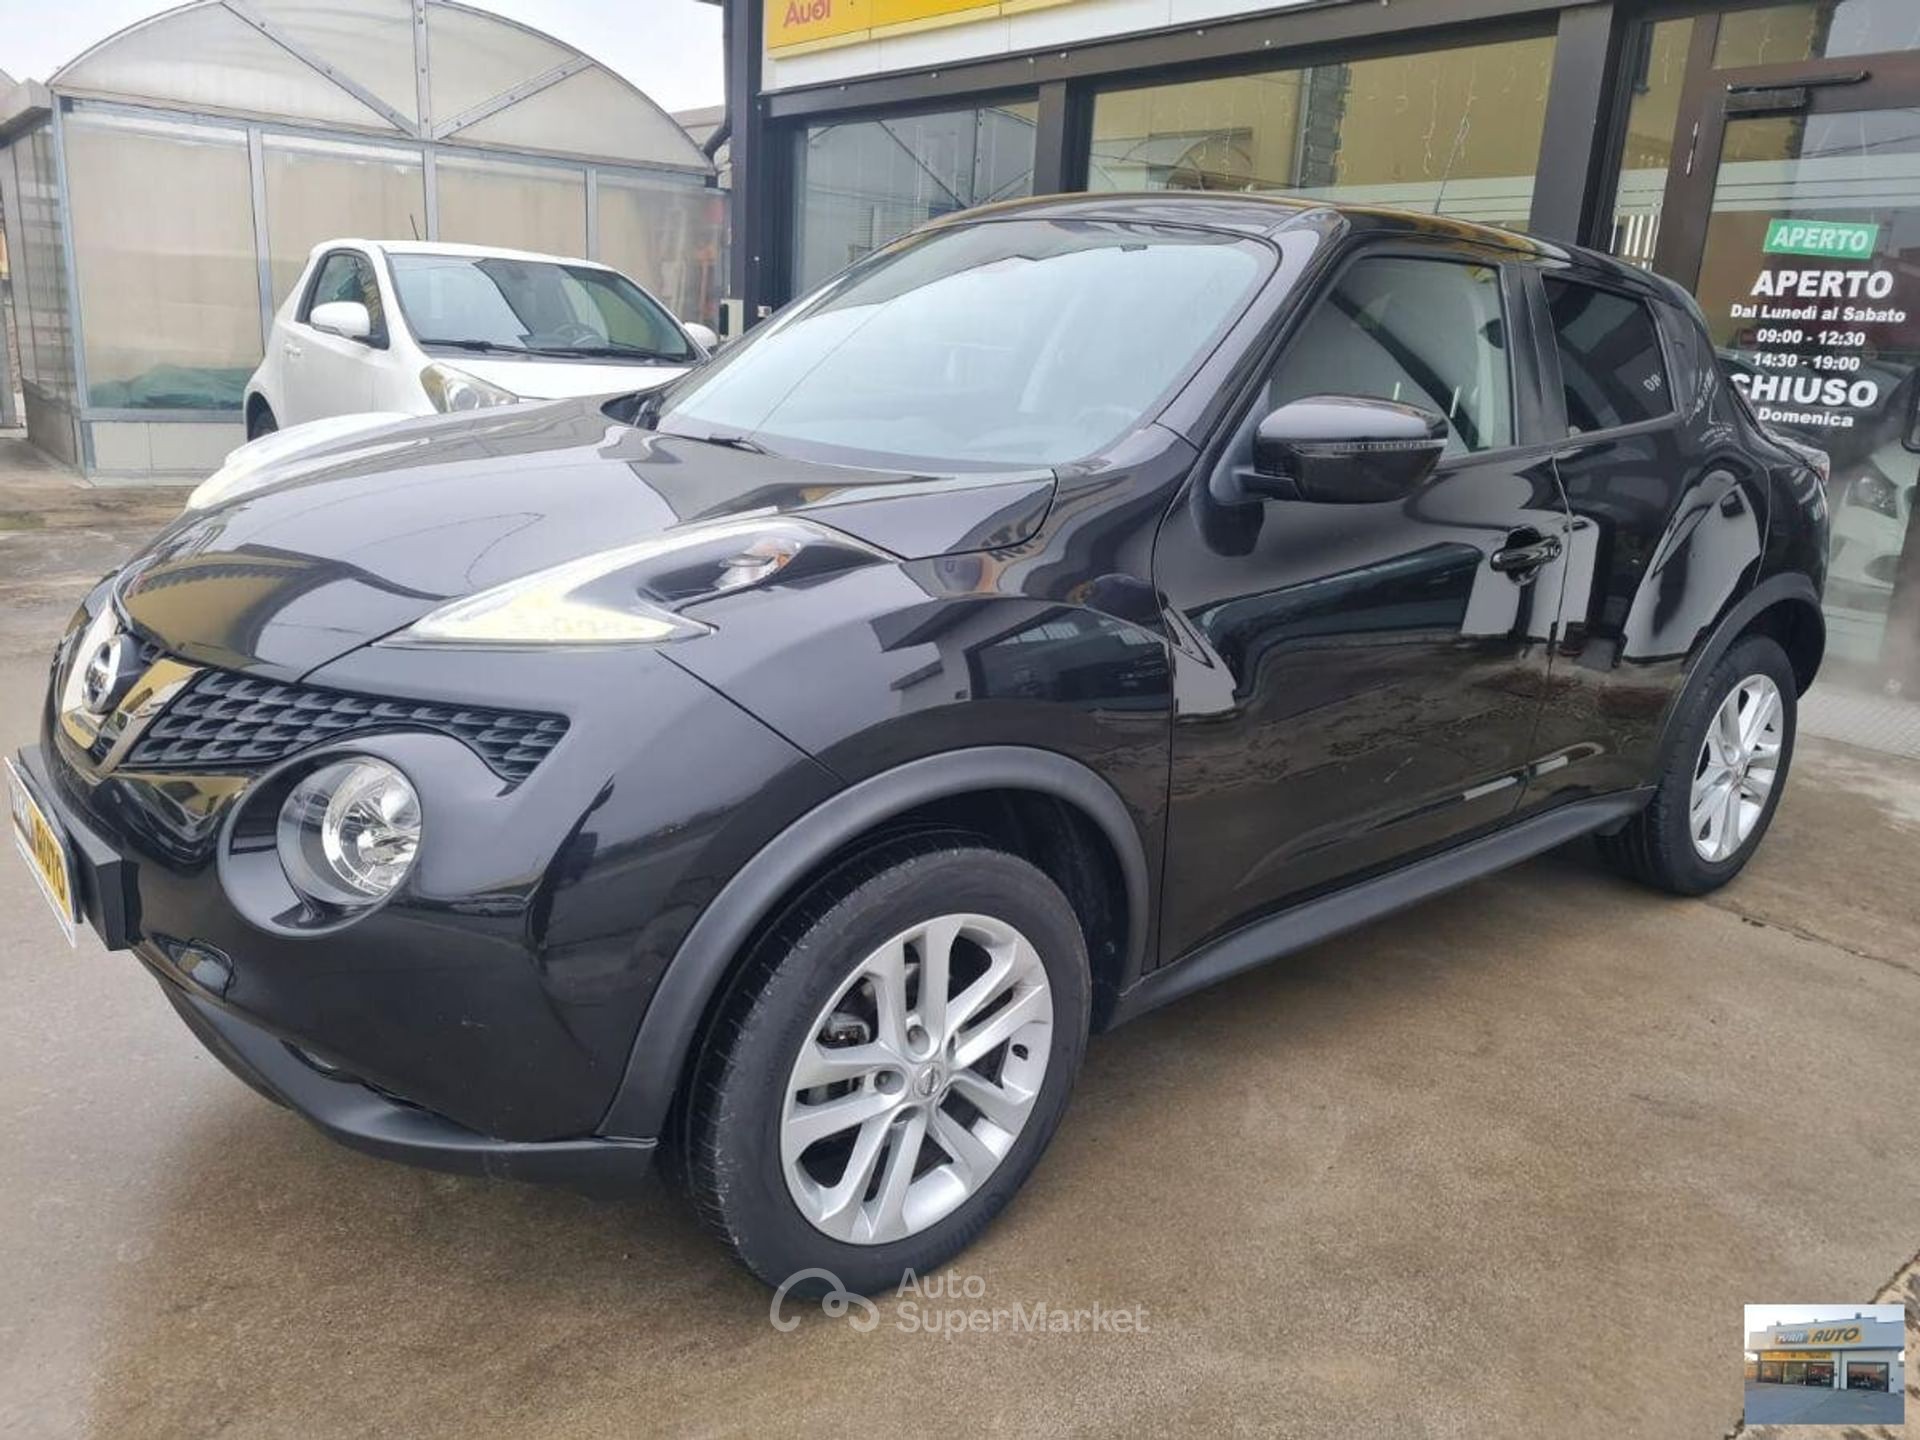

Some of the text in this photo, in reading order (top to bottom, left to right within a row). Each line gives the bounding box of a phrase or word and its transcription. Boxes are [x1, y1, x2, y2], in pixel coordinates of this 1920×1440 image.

[1772, 226, 1868, 251] APERTO
[1751, 270, 1893, 298] APERTO
[1730, 304, 1757, 319] Dal
[1821, 309, 1837, 321] al
[1842, 307, 1906, 323] Sabato
[1757, 328, 1803, 345] 09:00
[1818, 331, 1866, 346] 12:30
[1752, 352, 1798, 368] 14:30
[1812, 355, 1861, 371] 19:00
[1758, 407, 1853, 427] Domenica
